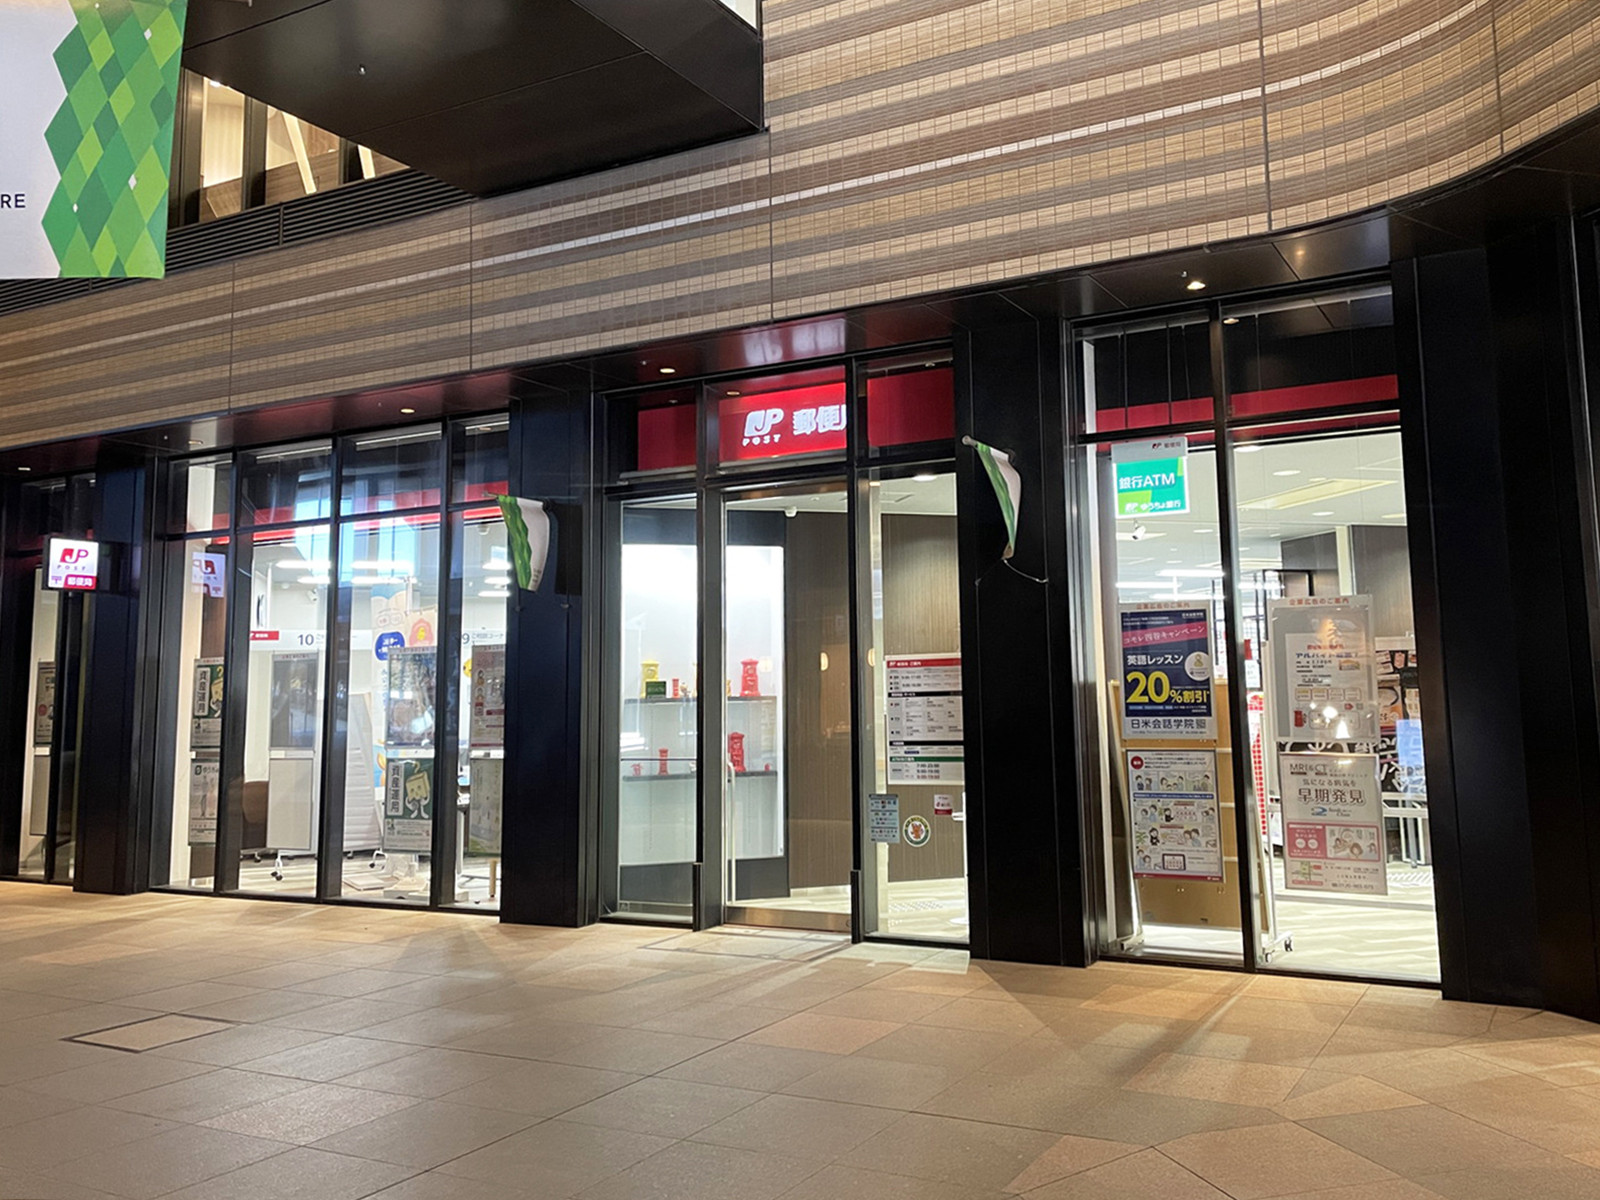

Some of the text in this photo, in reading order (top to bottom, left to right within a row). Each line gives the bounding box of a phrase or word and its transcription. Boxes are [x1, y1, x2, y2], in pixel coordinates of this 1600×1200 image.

[742, 433, 781, 447] POST
[1119, 472, 1176, 490] 銀行ATM
[298, 633, 315, 646] 10
[1127, 654, 1184, 666] 英語レッスン
[1131, 719, 1195, 729] 日米会話学院
[1298, 788, 1364, 804] 早期発見
